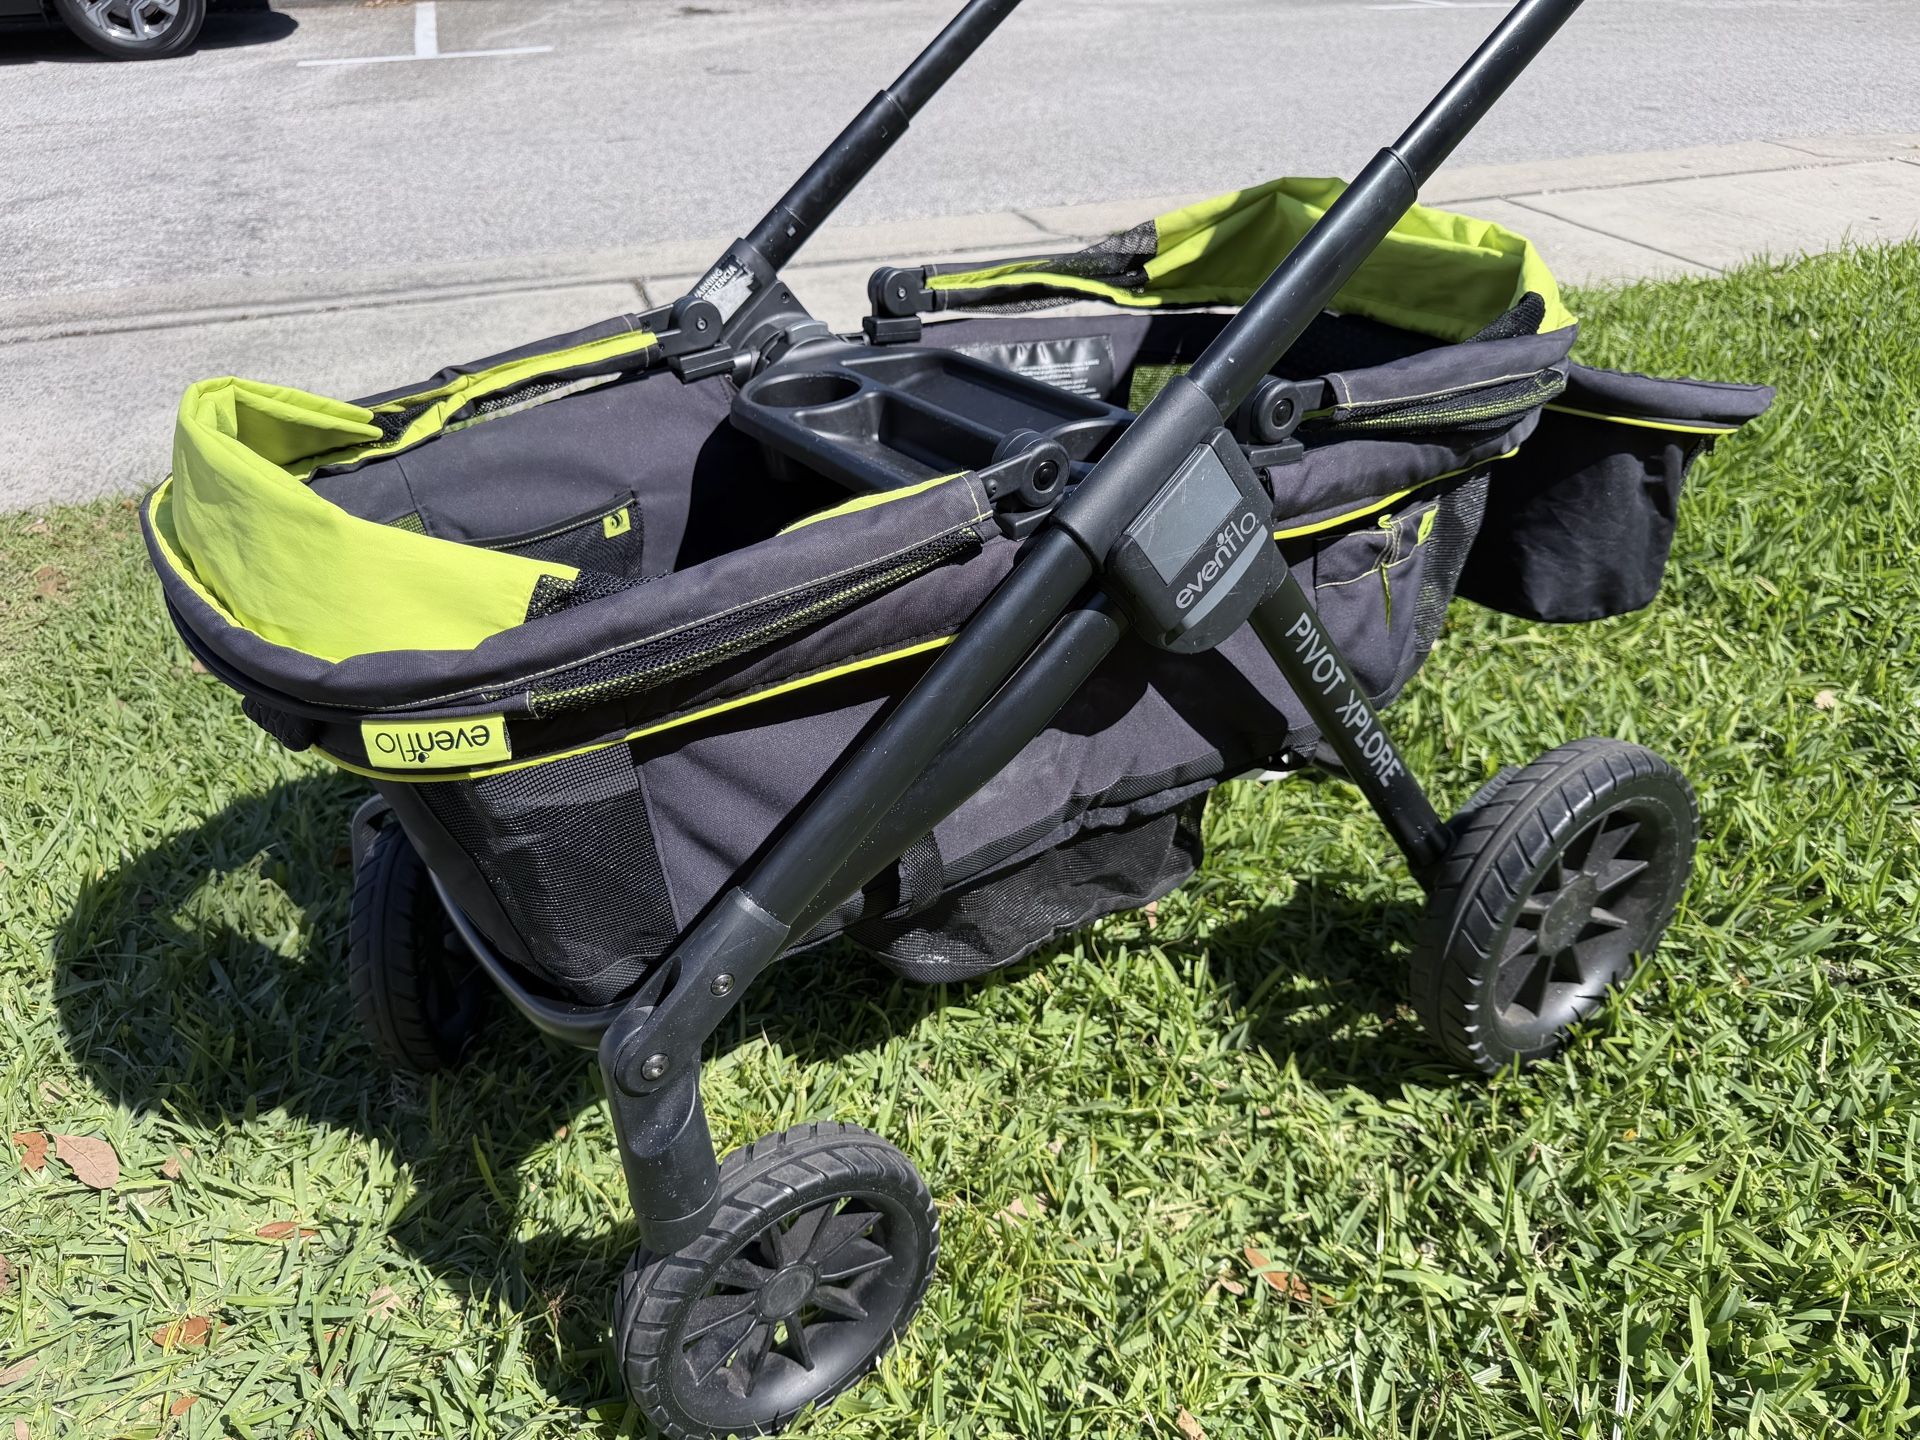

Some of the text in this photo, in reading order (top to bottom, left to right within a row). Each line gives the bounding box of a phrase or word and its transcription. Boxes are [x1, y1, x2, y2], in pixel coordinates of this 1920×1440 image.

[694, 266, 723, 298] ARNING
[1175, 511, 1257, 609] evenflo
[1284, 611, 1403, 788] PIVOT XPLORE
[375, 724, 490, 763] evenflo
